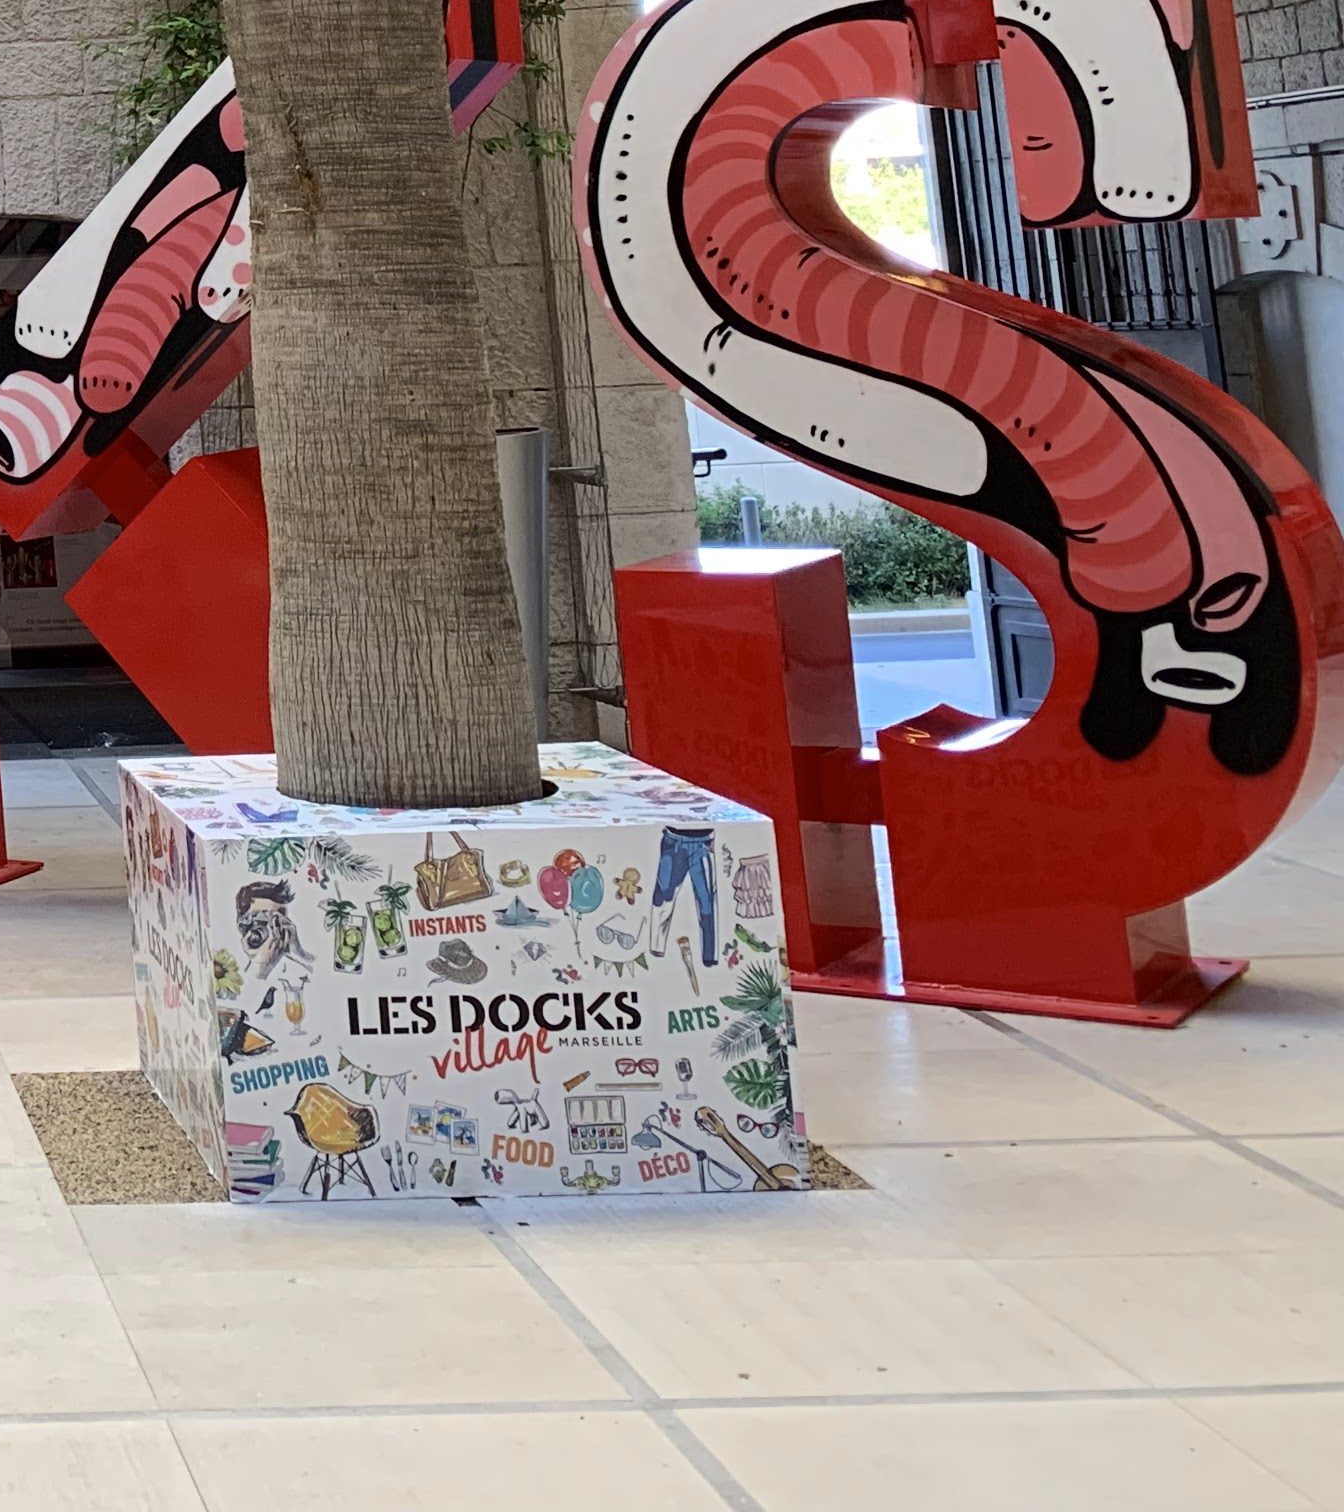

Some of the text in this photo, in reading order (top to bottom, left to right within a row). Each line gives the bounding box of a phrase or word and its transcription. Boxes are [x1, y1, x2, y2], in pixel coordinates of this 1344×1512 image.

[409, 914, 487, 937] INSTANTS
[347, 991, 642, 1035] LES DOCKS
[668, 1005, 721, 1035] ARTS
[431, 1024, 554, 1085] village
[559, 1036, 643, 1047] MARSEILLE
[230, 1055, 329, 1095] SHOPPING
[491, 1134, 555, 1168] FOOD
[637, 1152, 691, 1182] DÉCO
